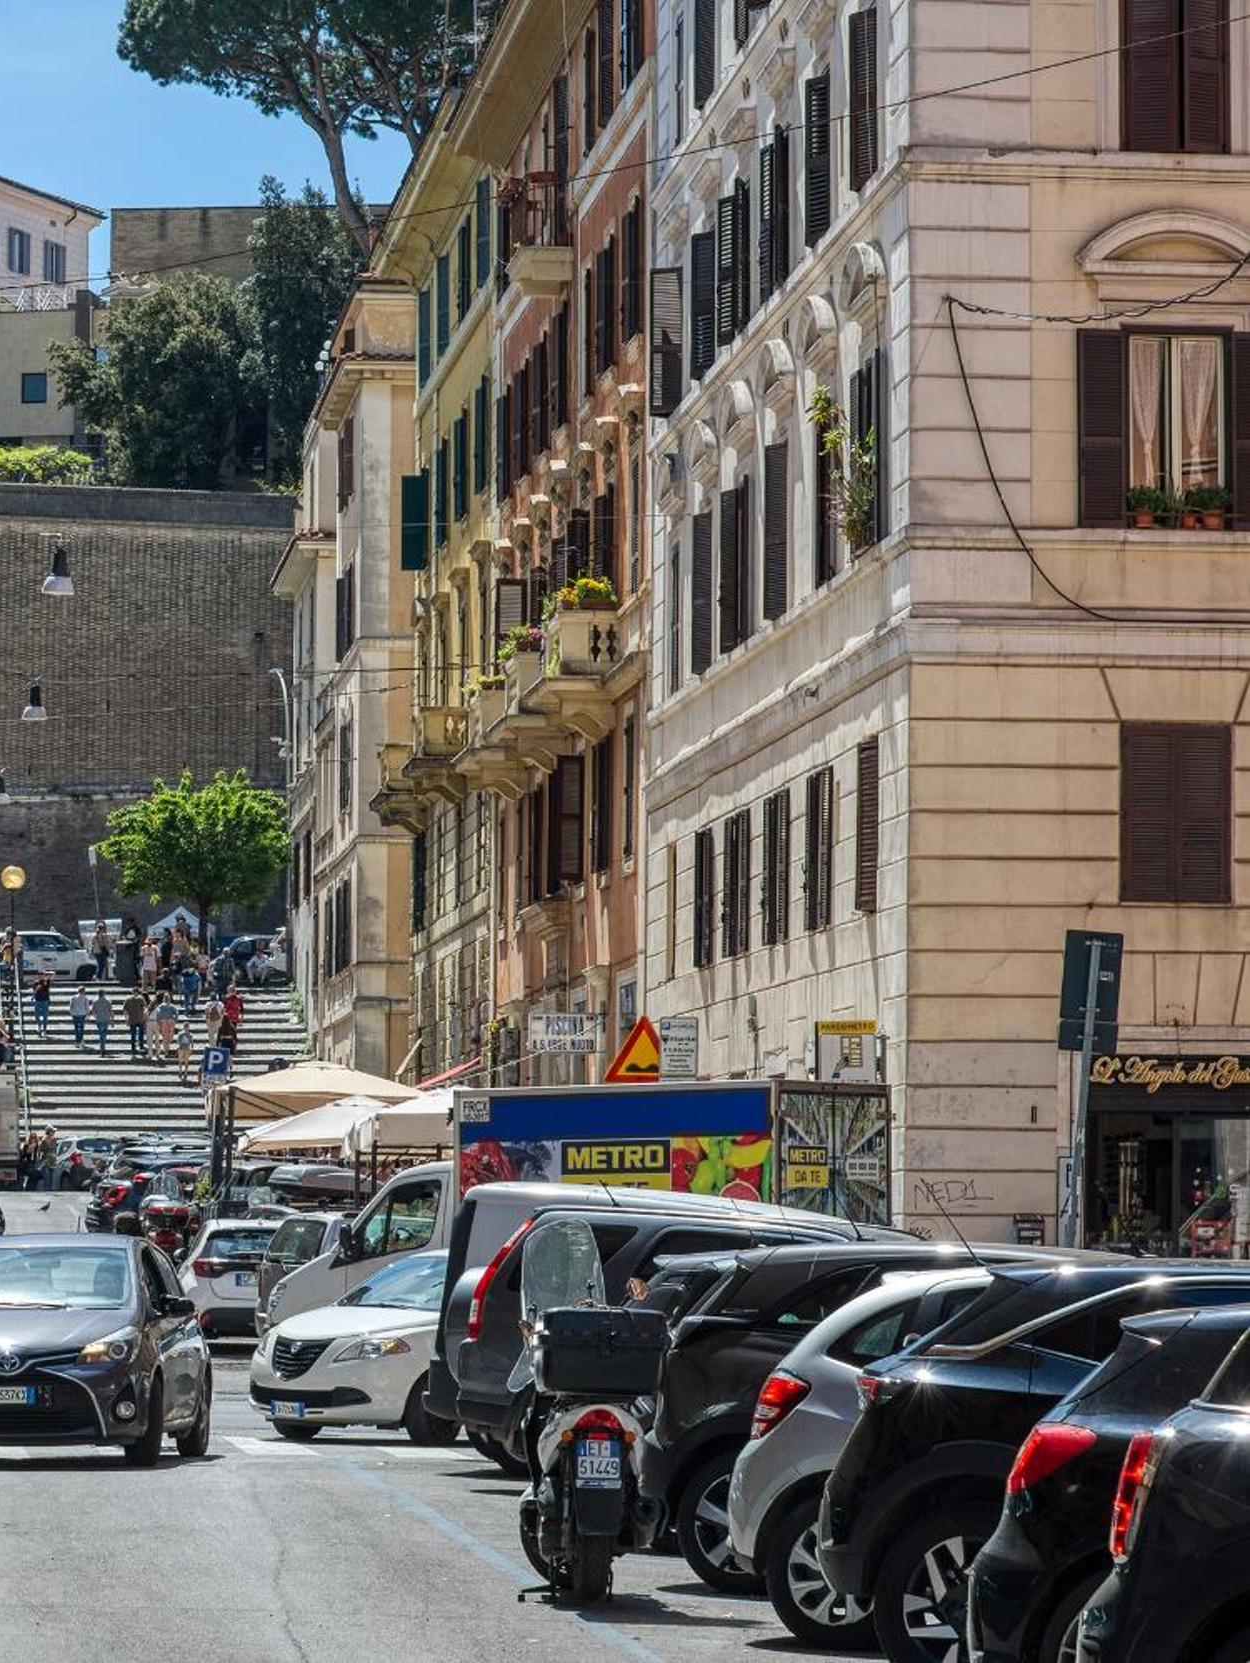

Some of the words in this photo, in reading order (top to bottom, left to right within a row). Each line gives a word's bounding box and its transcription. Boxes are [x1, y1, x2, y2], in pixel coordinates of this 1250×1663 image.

[209, 1051, 224, 1070] P
[567, 1145, 664, 1169] METRO
[790, 1149, 826, 1162] METRO
[794, 1171, 806, 1182] DA
[811, 1171, 821, 1183] TE
[580, 1460, 618, 1475] 51449
